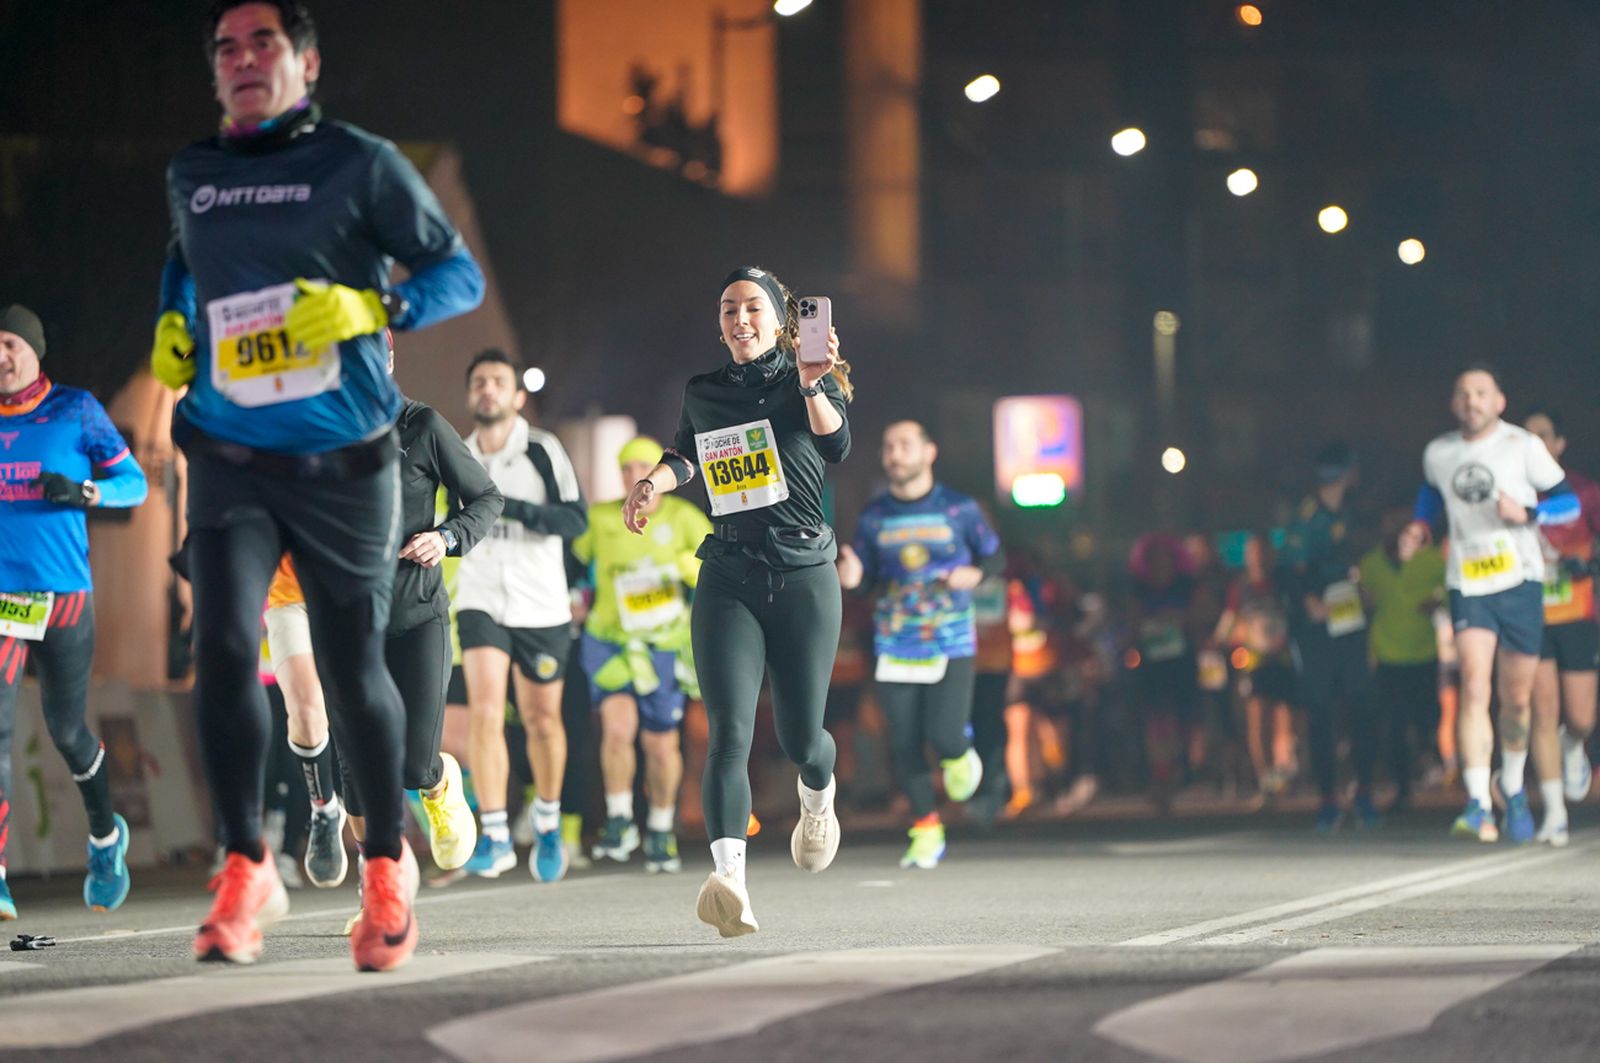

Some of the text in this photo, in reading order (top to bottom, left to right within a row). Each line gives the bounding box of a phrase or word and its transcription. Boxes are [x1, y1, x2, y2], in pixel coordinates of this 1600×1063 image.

[216, 187, 255, 207] NTT
[705, 445, 743, 462] SAN ANTÓN
[708, 452, 770, 486] 13644
